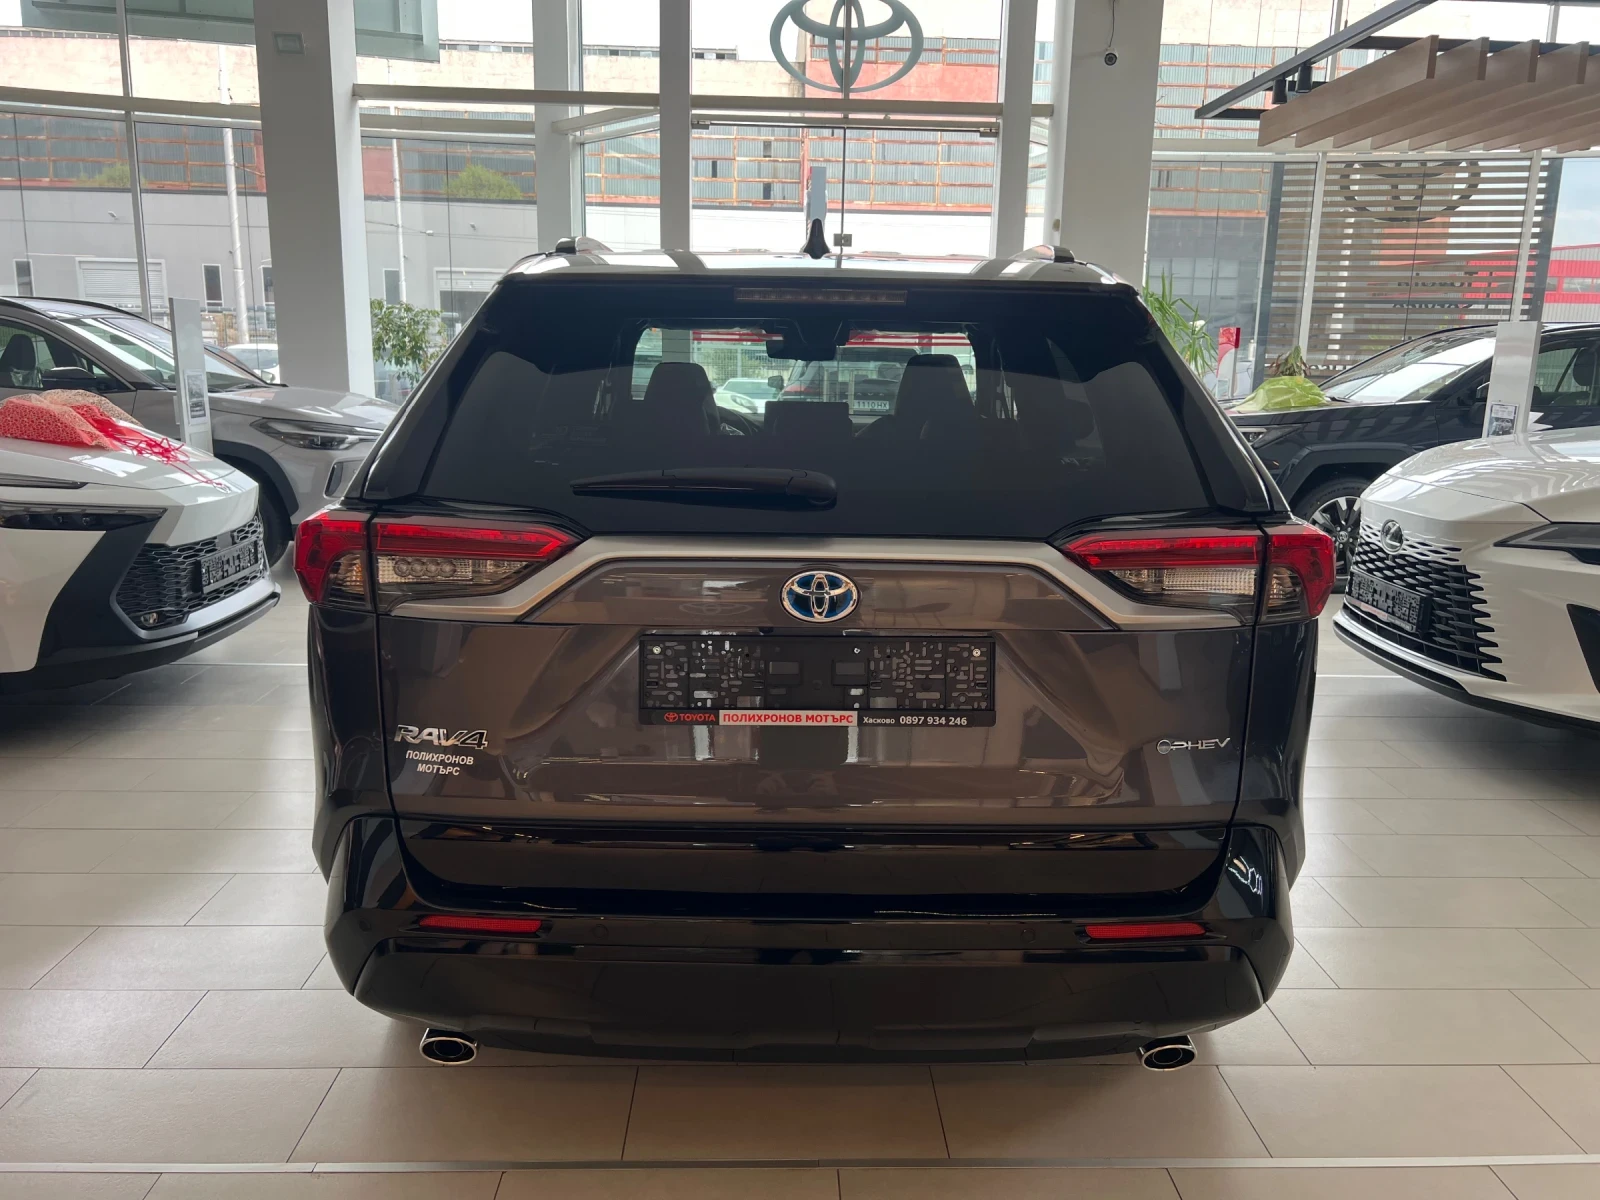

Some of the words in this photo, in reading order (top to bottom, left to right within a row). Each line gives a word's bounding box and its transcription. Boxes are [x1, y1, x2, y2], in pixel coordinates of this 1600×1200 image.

[680, 713, 716, 722] TOYOTA
[723, 713, 803, 723] ПОЛИХРОНОВ
[805, 714, 854, 724] МОТЪРС
[863, 716, 896, 724] Хасково
[899, 715, 925, 725] 0897
[927, 716, 946, 725] 934
[948, 717, 968, 726] 246
[394, 724, 489, 750] RAV4
[1170, 737, 1231, 751] PHEV
[405, 750, 474, 766] ПОЛИХРОНОВ
[416, 763, 461, 776] МОТЪРС
